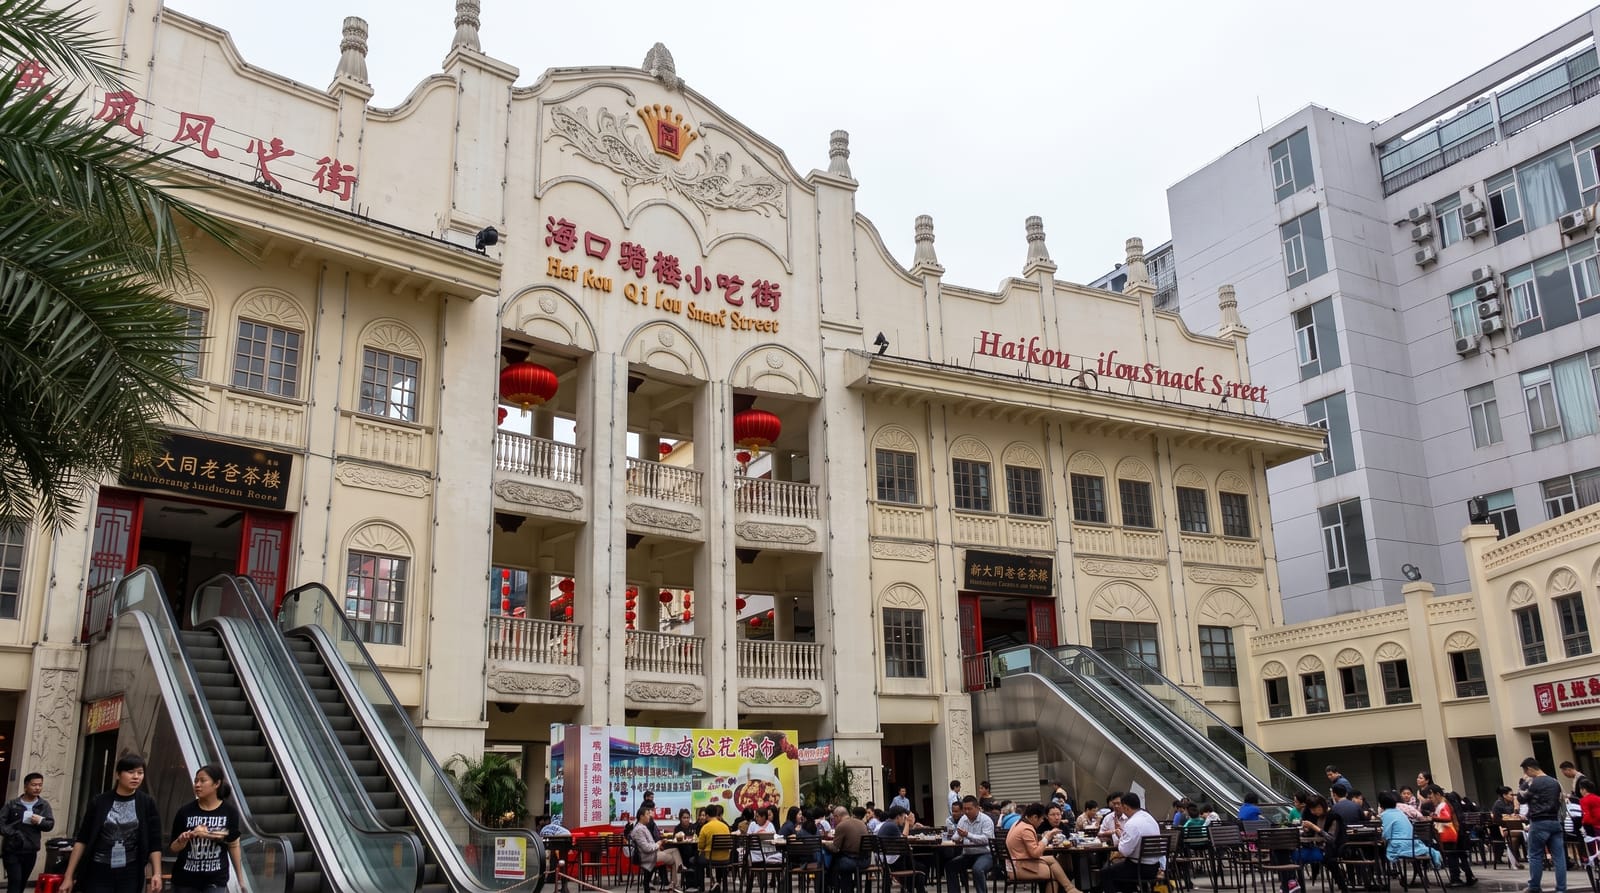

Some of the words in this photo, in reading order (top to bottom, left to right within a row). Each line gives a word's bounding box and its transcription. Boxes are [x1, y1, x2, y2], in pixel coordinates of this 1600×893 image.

[545, 215, 782, 313] 海口骑楼小吃街
[624, 282, 649, 306] Qi
[730, 311, 780, 334] Street
[978, 330, 1071, 369] Haikou
